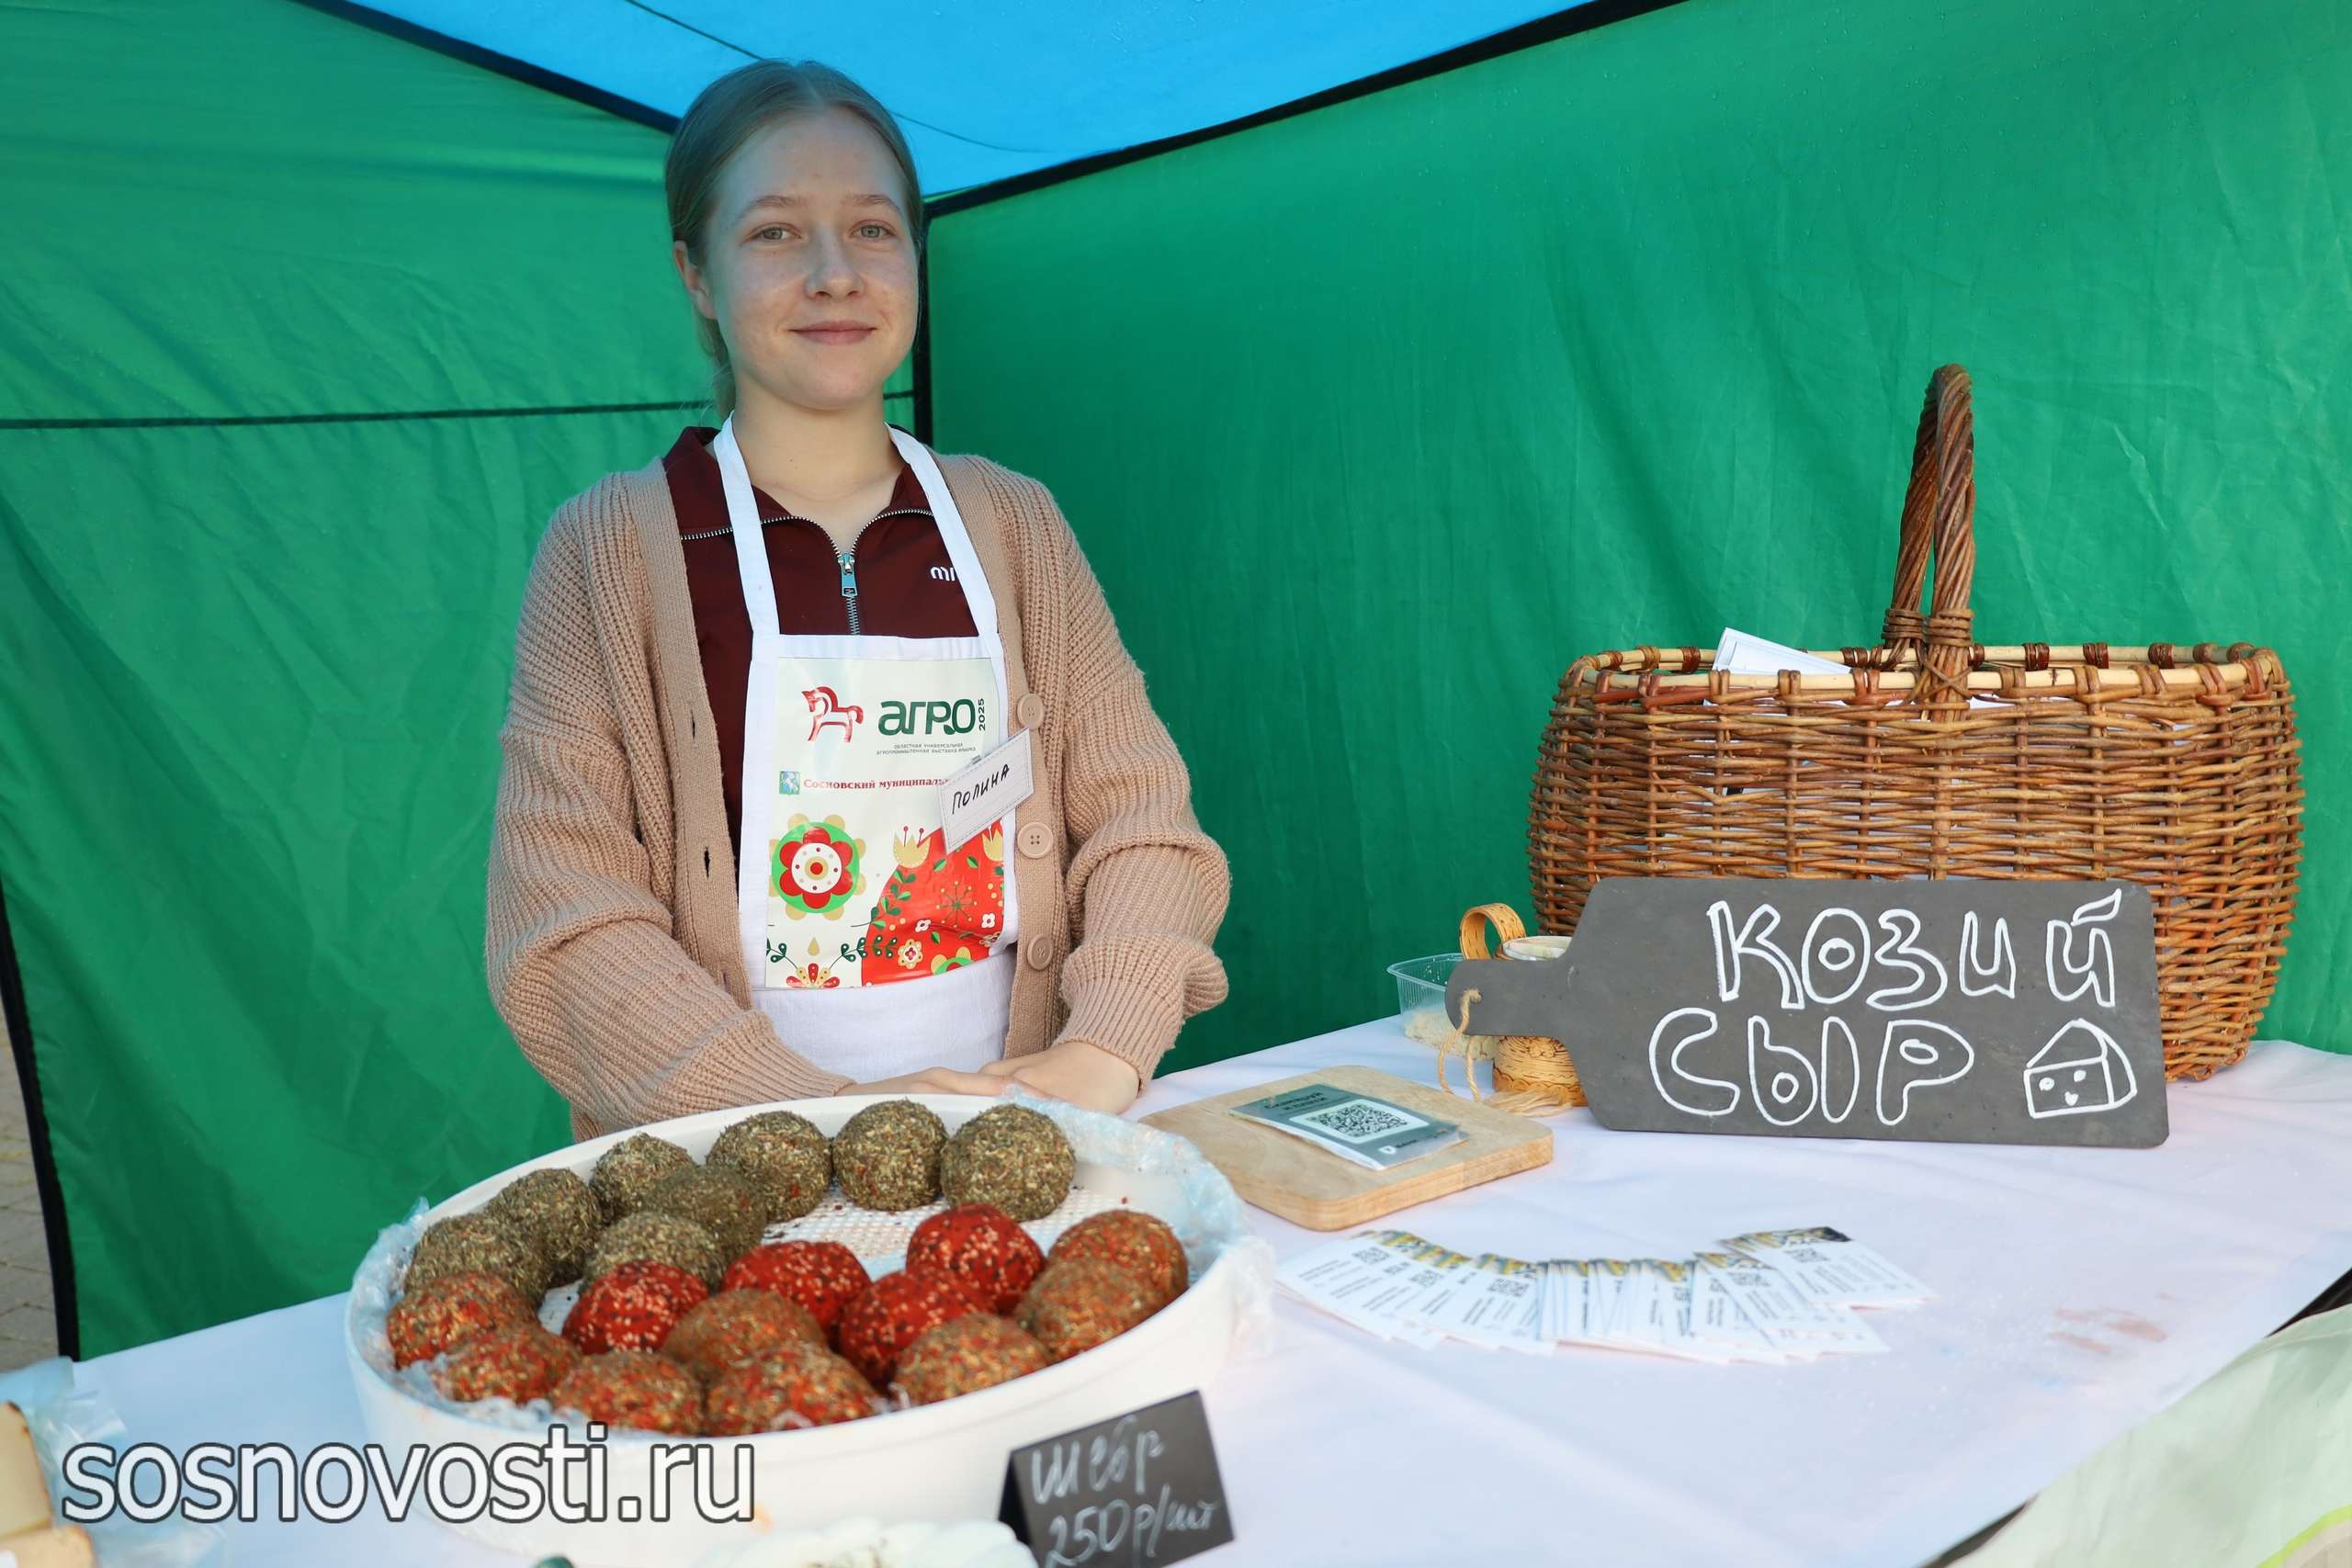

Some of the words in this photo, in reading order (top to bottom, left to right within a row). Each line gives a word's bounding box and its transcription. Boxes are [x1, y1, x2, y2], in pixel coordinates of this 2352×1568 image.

[978, 697, 986, 731] 2025
[803, 777, 876, 790] Сосновский
[878, 777, 950, 790] муниципаль
[952, 763, 1010, 815] ПОЛИНА
[1706, 888, 2123, 1011] КОЗИЙ
[1648, 1007, 1975, 1127] СЫР
